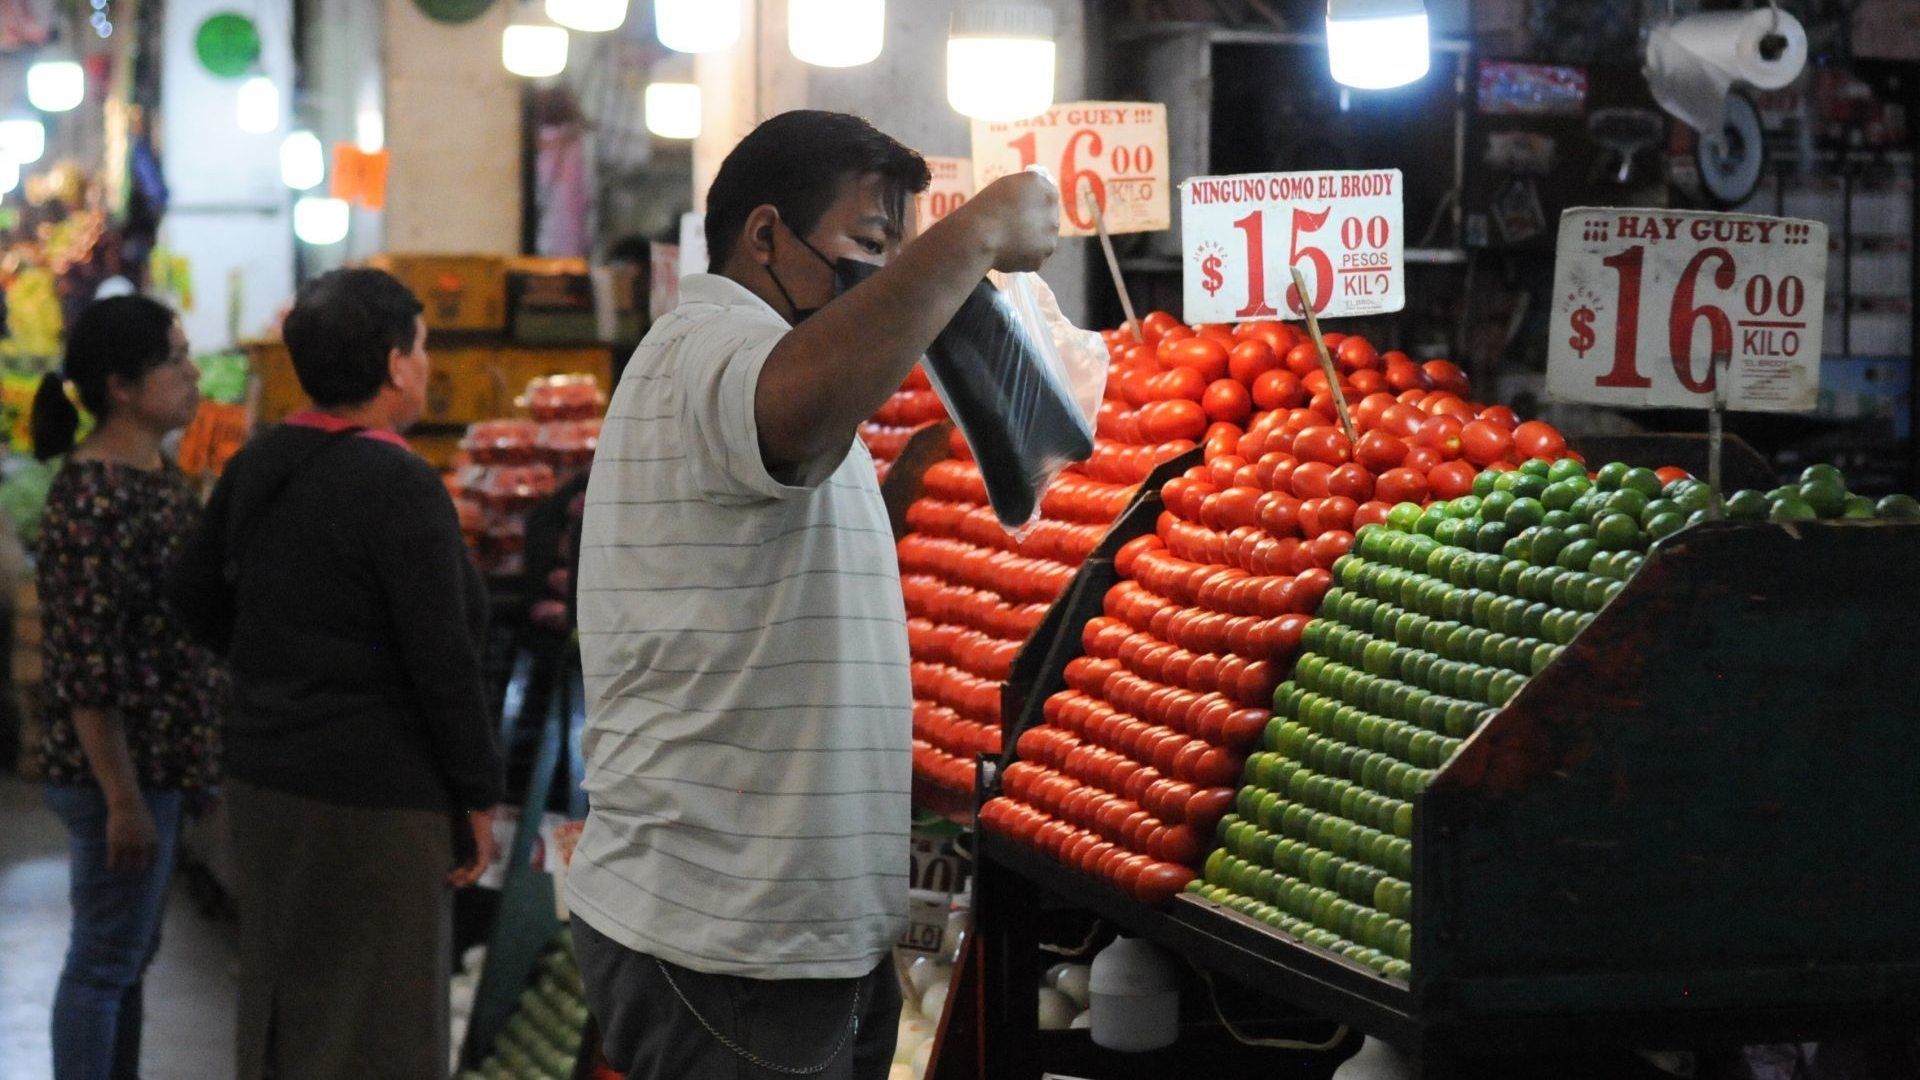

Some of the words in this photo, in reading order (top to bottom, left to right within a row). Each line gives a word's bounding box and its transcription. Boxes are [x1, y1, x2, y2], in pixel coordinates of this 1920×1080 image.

[1067, 109, 1129, 126] GUEY
[1111, 145, 1154, 176] 00
[1191, 178, 1266, 205] NINGUNO
[1269, 176, 1314, 201] COMO
[1318, 176, 1338, 199] EL
[1340, 173, 1394, 197] BRODY
[1617, 216, 1684, 240] HAY
[1690, 219, 1779, 243] GUEY
[1783, 223, 1810, 245] !!!
[1202, 253, 1224, 298] $
[1233, 205, 1334, 318] 15
[1340, 215, 1390, 251] 00
[1342, 251, 1389, 267] PESOS
[1344, 273, 1390, 297] KILO
[1568, 304, 1596, 359] $
[1595, 245, 1736, 394] 16
[1745, 274, 1805, 318] 00
[1743, 329, 1800, 357] KILO
